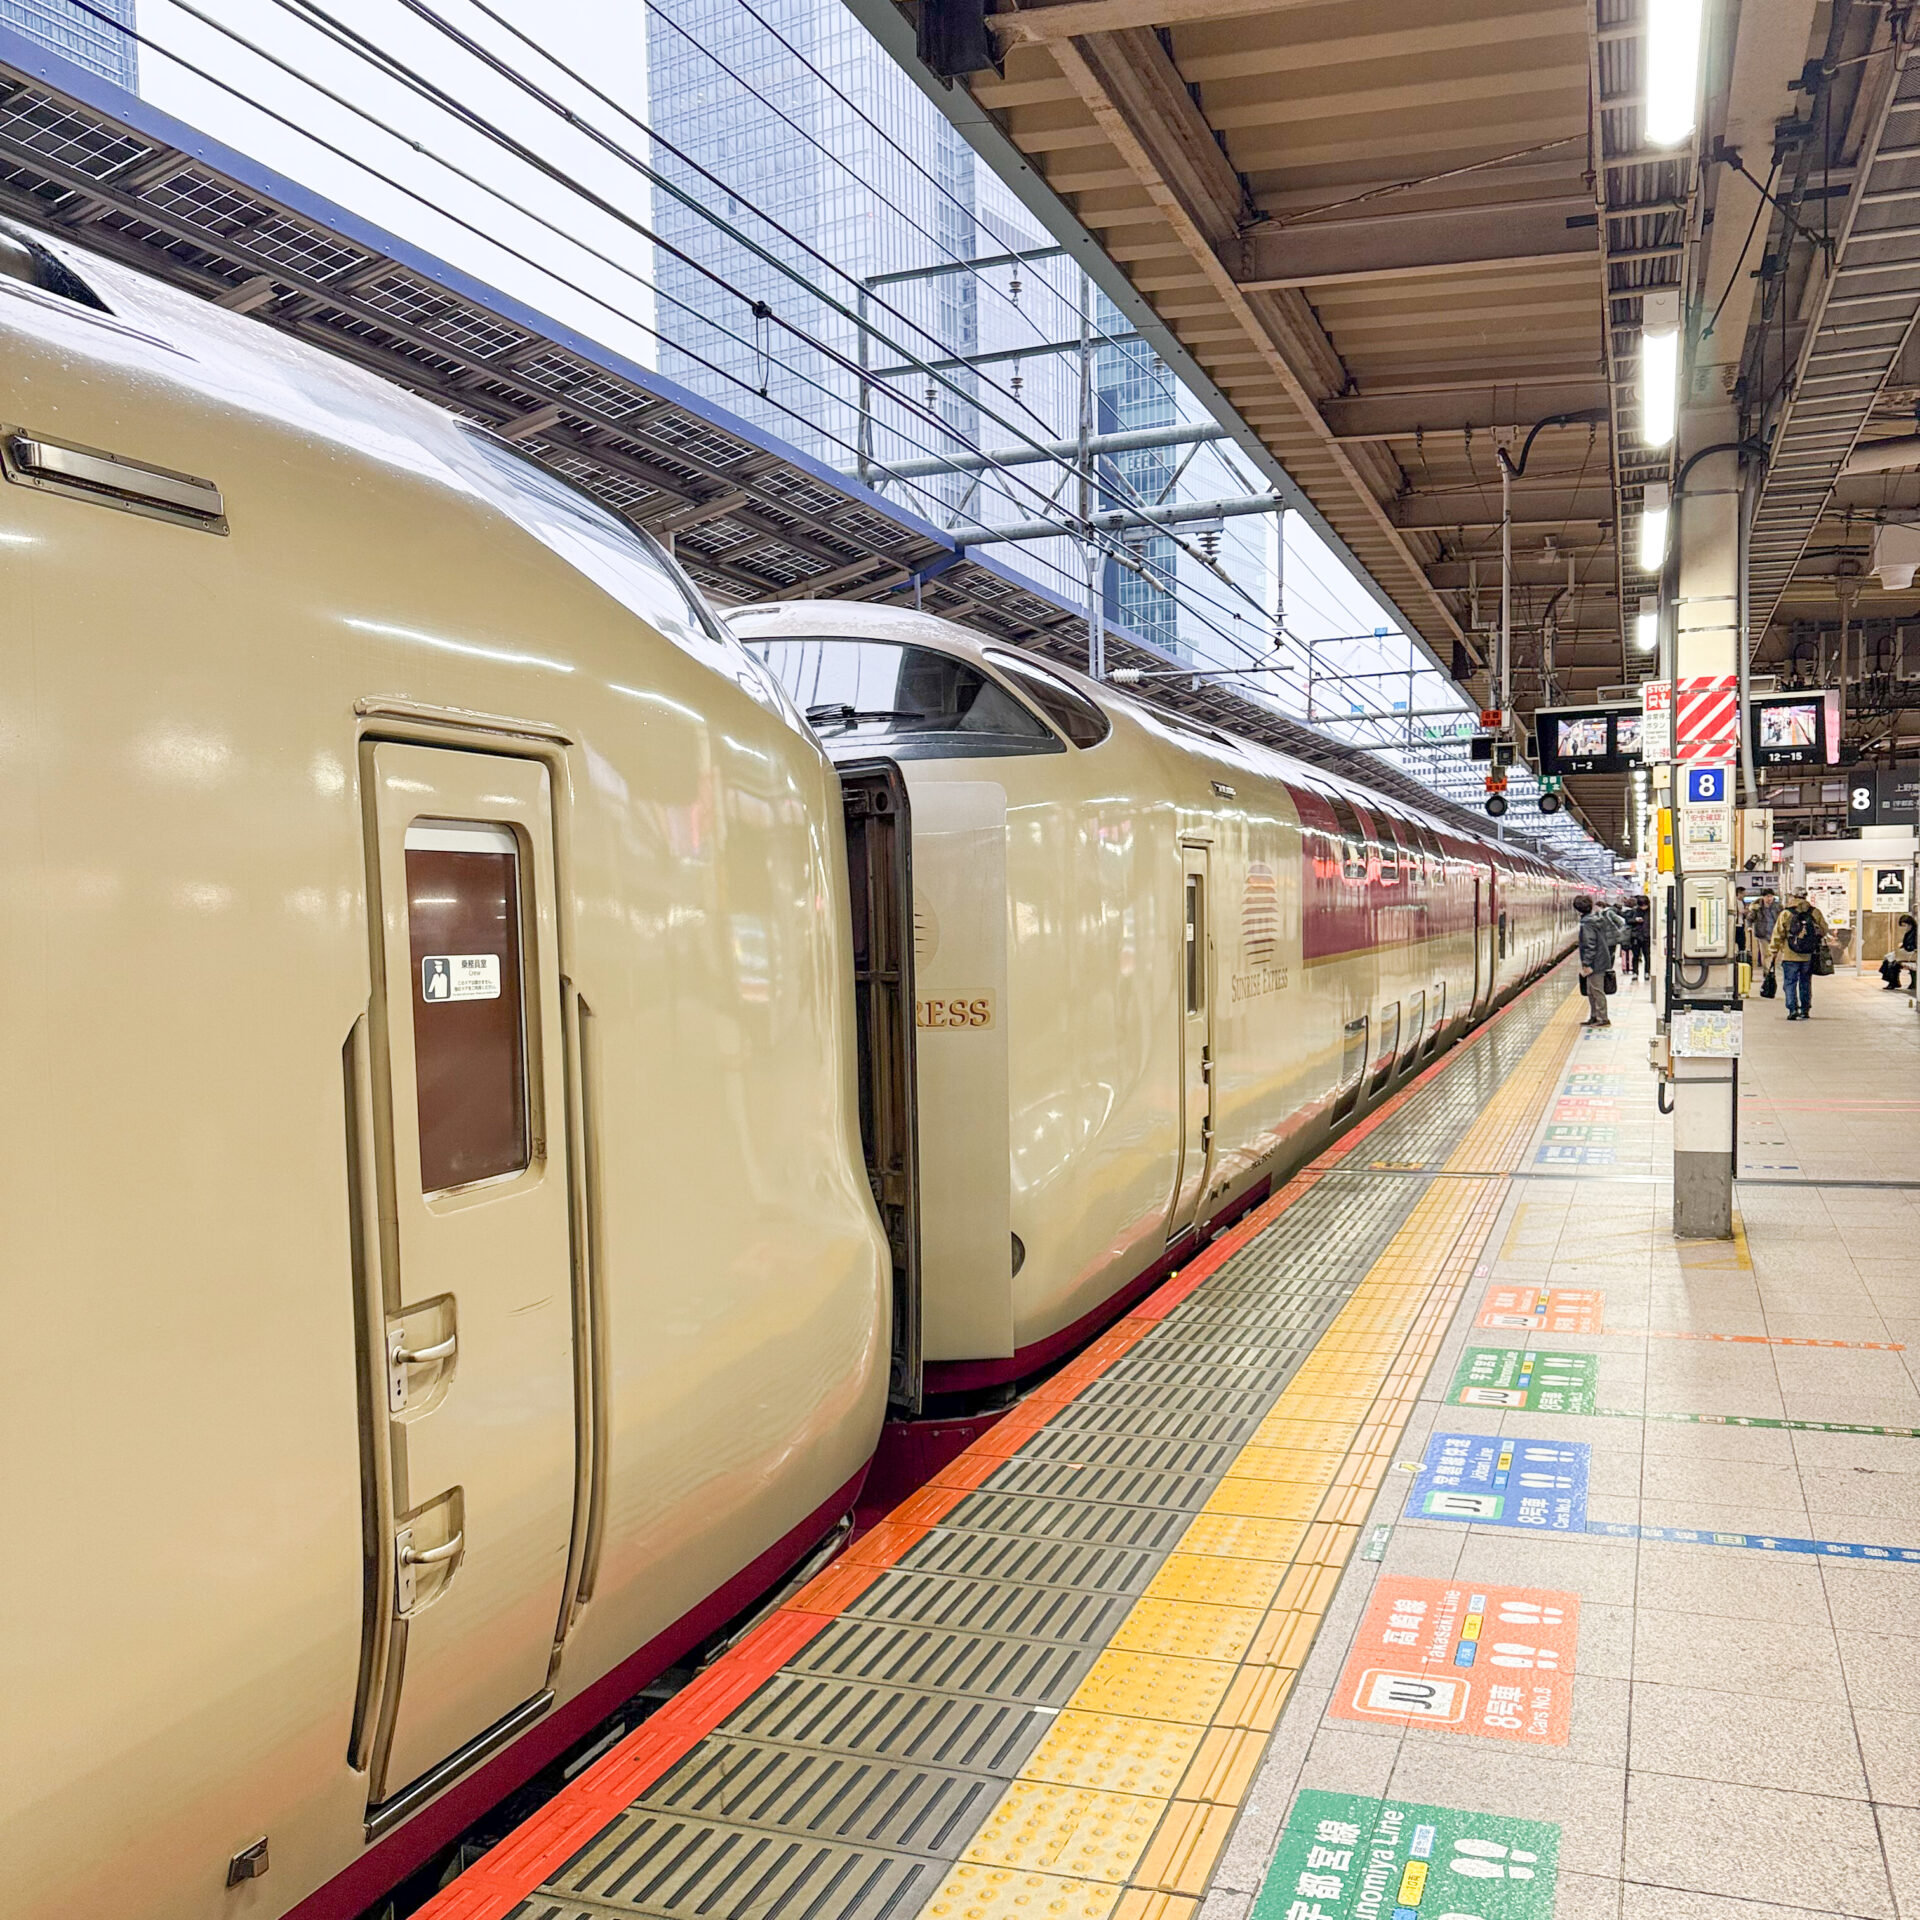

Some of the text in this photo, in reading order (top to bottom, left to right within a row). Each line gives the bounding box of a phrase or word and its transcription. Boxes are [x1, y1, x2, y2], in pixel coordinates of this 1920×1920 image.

[1698, 773, 1715, 797] 8
[1852, 787, 1871, 810] 8
[1445, 1498, 1482, 1511] JJ
[1518, 1497, 1549, 1524] 8号車
[1382, 1599, 1428, 1646] 高崎線
[1421, 1589, 1461, 1664] Takasaki Line
[1388, 1680, 1436, 1709] JU
[1483, 1684, 1526, 1728] 8号車
[1527, 1686, 1551, 1735] Cars No.8
[1371, 1810, 1404, 1845] Line
